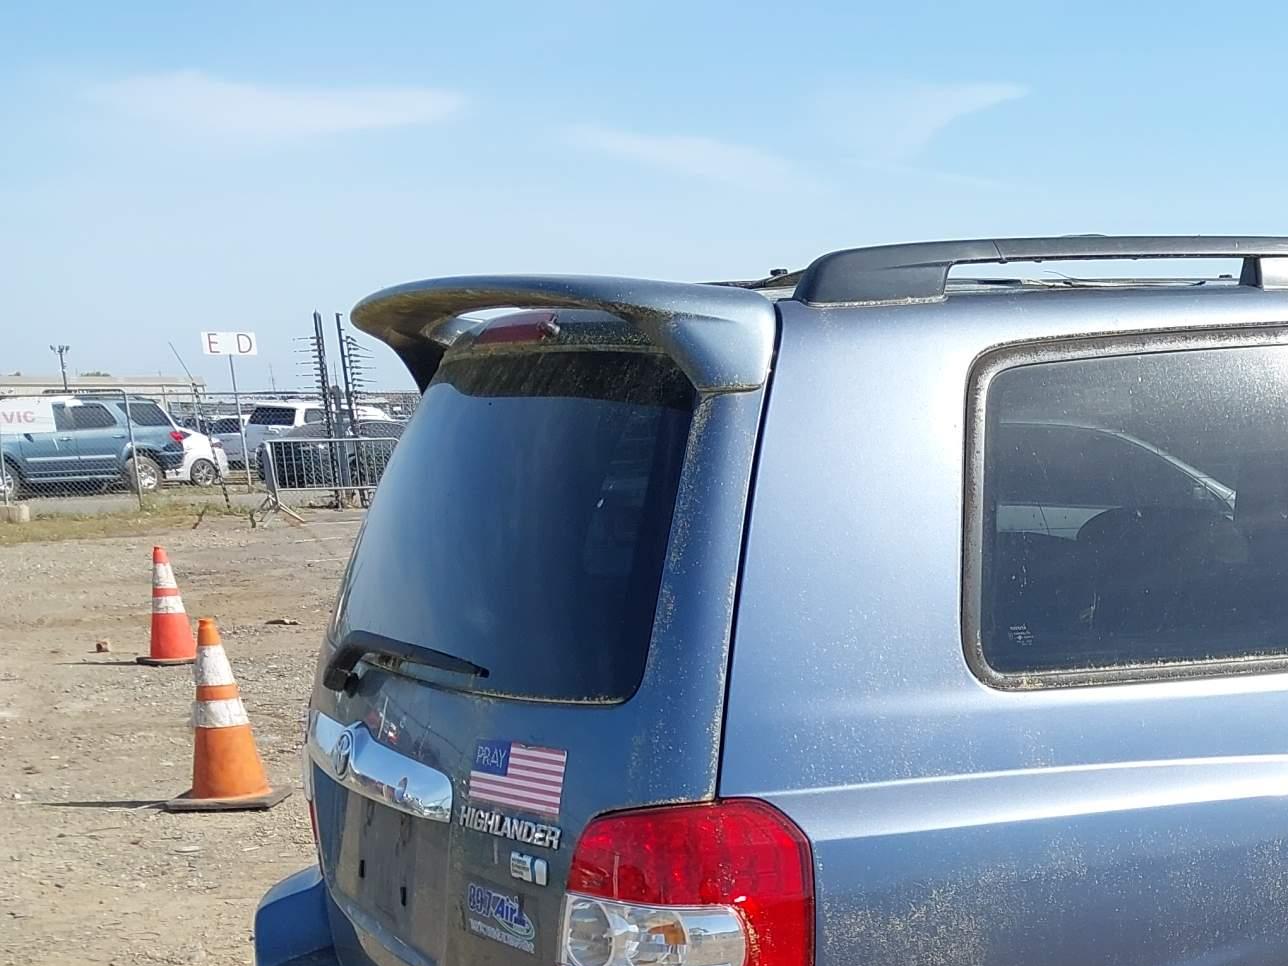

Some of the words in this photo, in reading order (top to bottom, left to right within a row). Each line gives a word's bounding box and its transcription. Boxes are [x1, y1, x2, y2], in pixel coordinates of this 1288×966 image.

[207, 333, 221, 353] E
[236, 333, 252, 353] D
[476, 745, 507, 769] PRAY
[460, 805, 561, 850] HIGHLANDER
